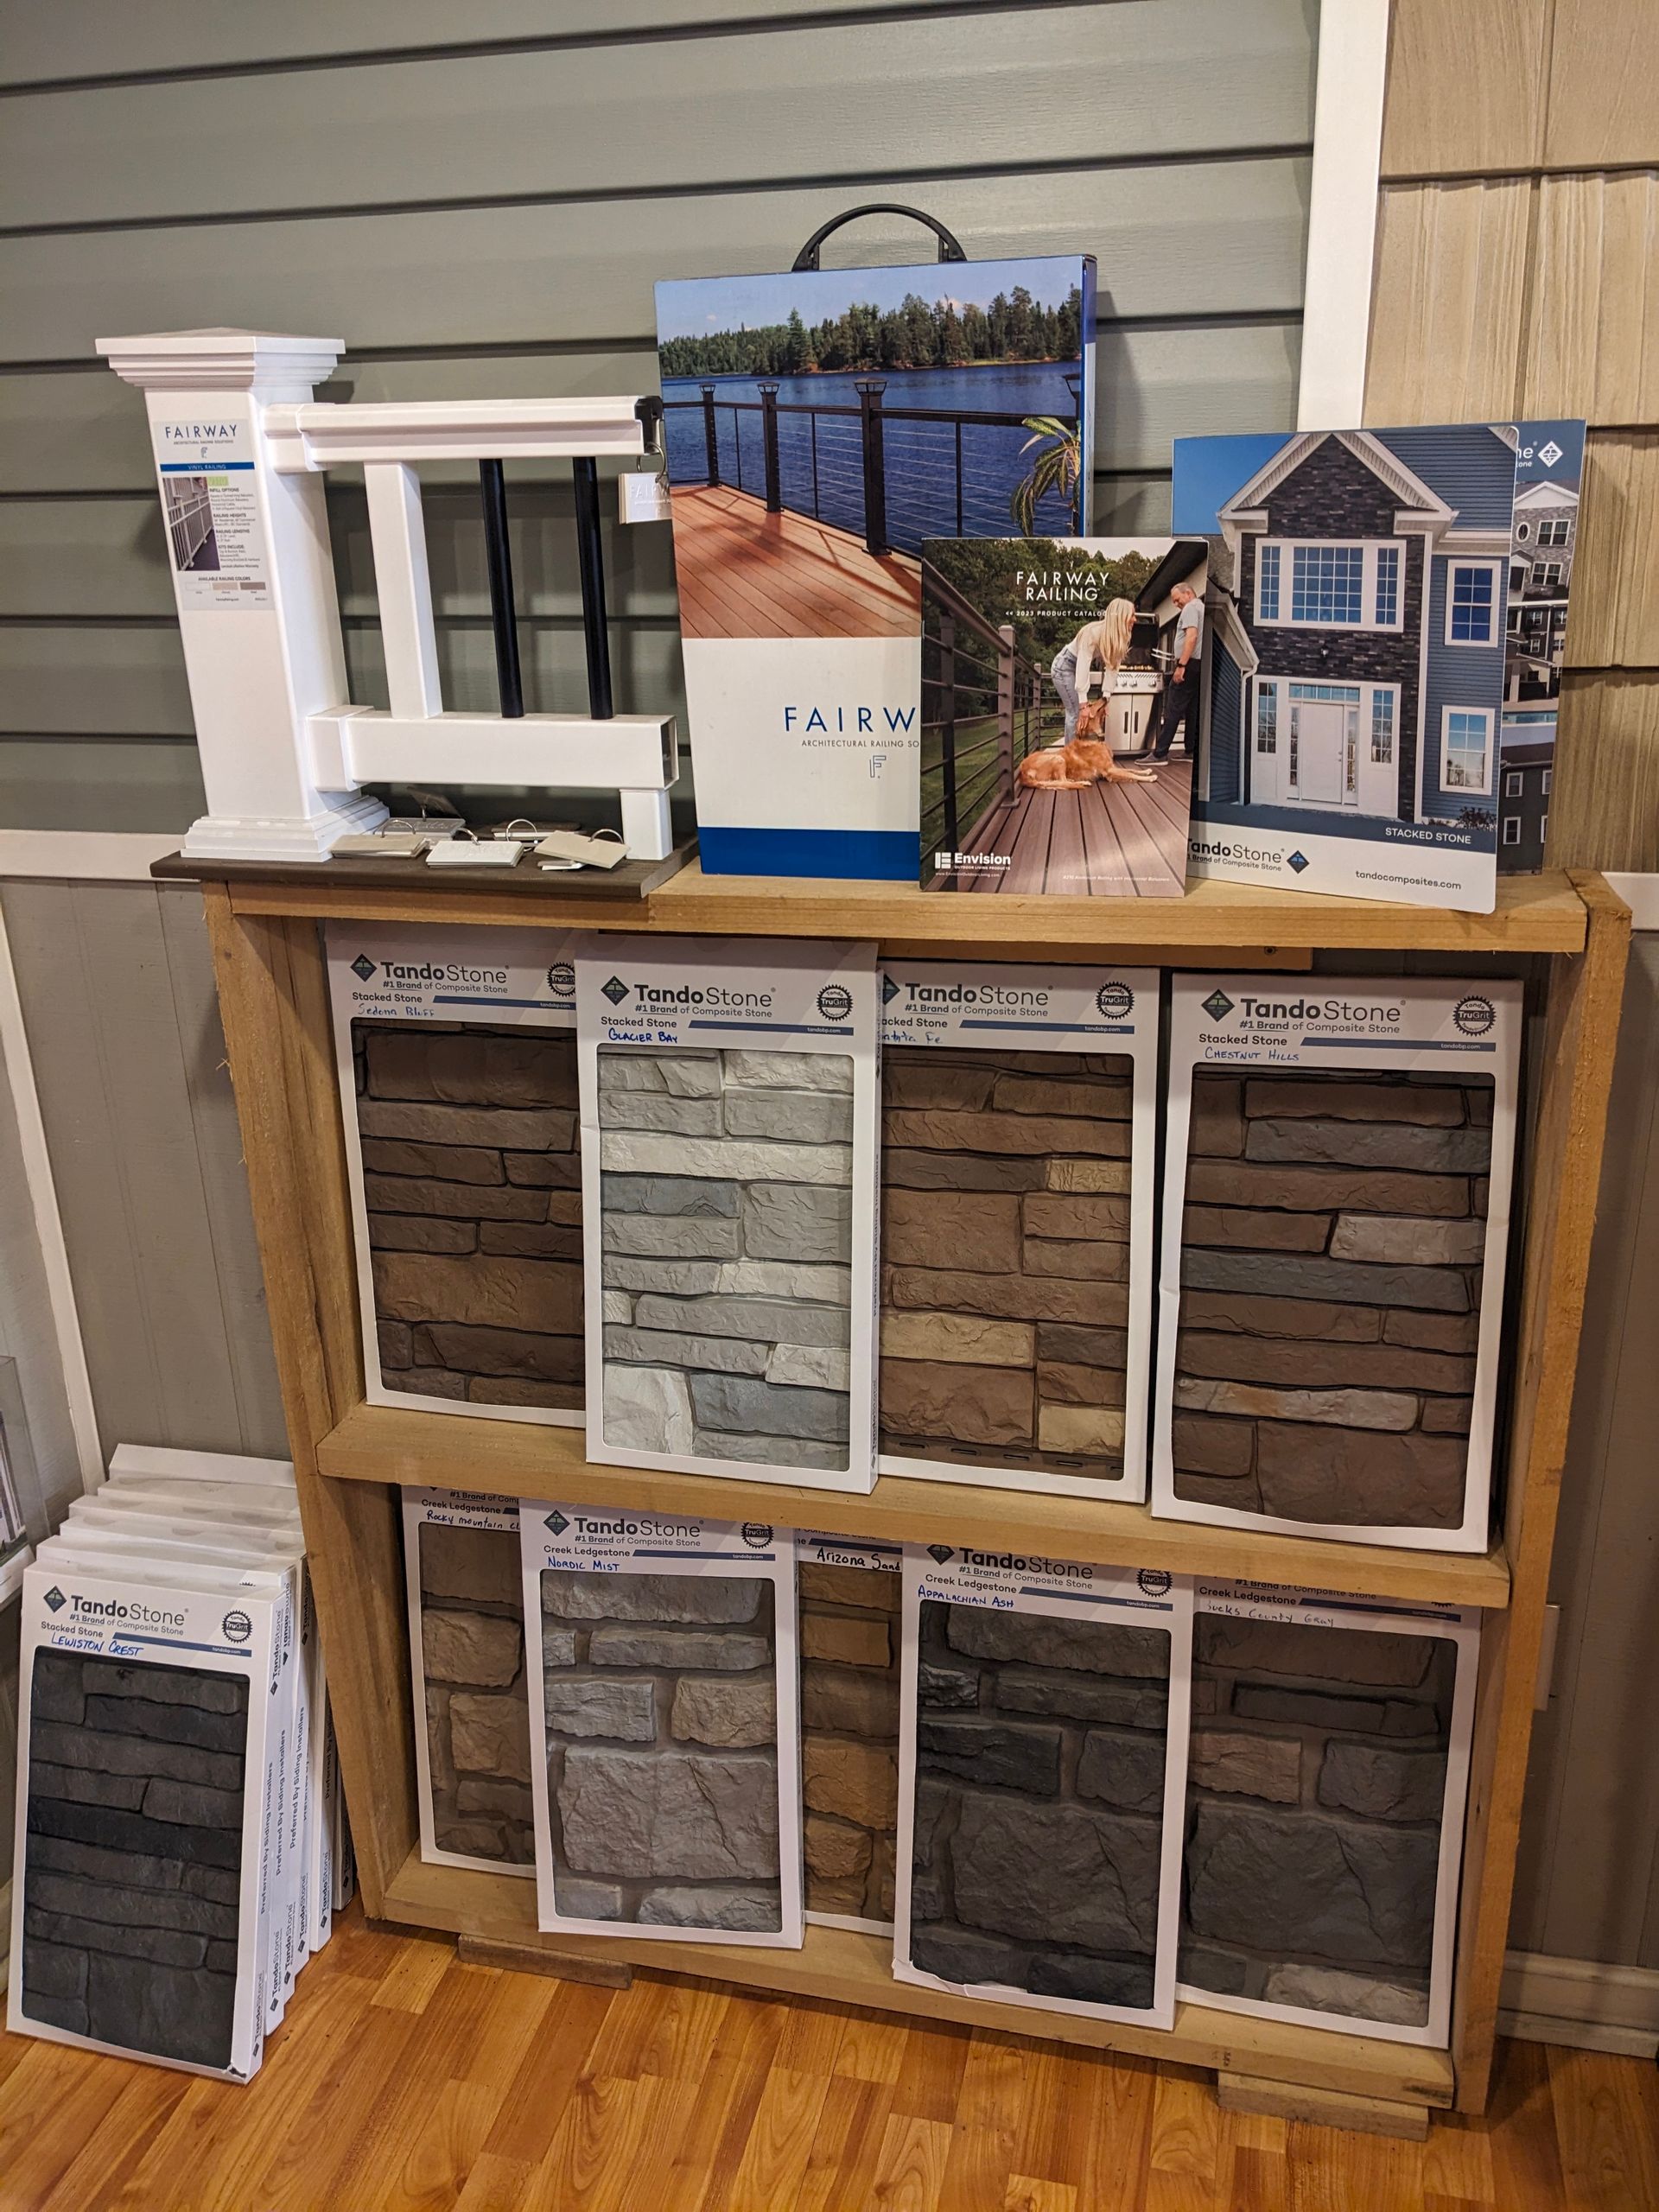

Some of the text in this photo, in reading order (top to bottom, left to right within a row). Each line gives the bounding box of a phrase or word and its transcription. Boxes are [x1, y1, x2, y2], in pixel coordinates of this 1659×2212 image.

[166, 425, 237, 438] FAIRWAY
[1016, 572, 1109, 586] FAIRWAY
[1027, 588, 1098, 601] RAILING
[785, 707, 916, 733] FAIRW
[1385, 828, 1471, 844] STACKED STONE
[955, 853, 1011, 864] Envision
[1223, 858, 1260, 869] Composite
[1356, 870, 1461, 890] tandocomposites.com
[435, 982, 481, 994] Composite
[352, 992, 422, 1003] Stacked Stone
[358, 1003, 397, 1016] Sedona
[680, 1006, 690, 1014] of
[692, 1006, 742, 1017] Composite
[745, 1009, 772, 1018] Stone
[920, 1005, 949, 1014] Brand
[951, 1005, 962, 1014] of
[963, 1006, 1016, 1017] Composite
[1020, 1008, 1048, 1017] Stone
[1458, 1012, 1490, 1020] TruGrit
[601, 1016, 677, 1028] Stacked Stone
[916, 1018, 948, 1028] Stone
[1239, 1020, 1400, 1034] #1 Brand of Composite Stone
[608, 1028, 677, 1043] GLACIER BAY
[1199, 1034, 1287, 1046] Stacked Stone
[1205, 1046, 1300, 1061] CHESTNUT HILLS
[422, 1499, 500, 1514] Creek Ledgestone
[427, 1510, 454, 1525] Rocky
[627, 1537, 673, 1547] Composite
[543, 1545, 630, 1557] Creek Ledgestone
[548, 1556, 620, 1572] NORDIC MIST
[817, 1547, 900, 1571] Arizona Sand
[925, 1574, 1017, 1594] Creek Ledgestone
[959, 1566, 1093, 1590] #1 Brand of Composite Stone
[1141, 1576, 1167, 1585] TruGrit
[918, 1585, 1014, 1607] APPALACHIAN ASH
[1199, 1586, 1296, 1605] Creek Ledgestone
[41, 1621, 104, 1638] Stacked Stone
[69, 1613, 79, 1622] #1
[82, 1616, 105, 1625] Brand
[118, 1619, 159, 1632] Composite
[161, 1626, 184, 1636] Stone
[51, 1631, 144, 1656] LEWISTON CREST
[289, 1707, 305, 1849] Preferred By Siding Installers
[277, 1812, 283, 1827] By
[263, 1848, 270, 1862] By
[260, 1865, 269, 1915] Preferred
